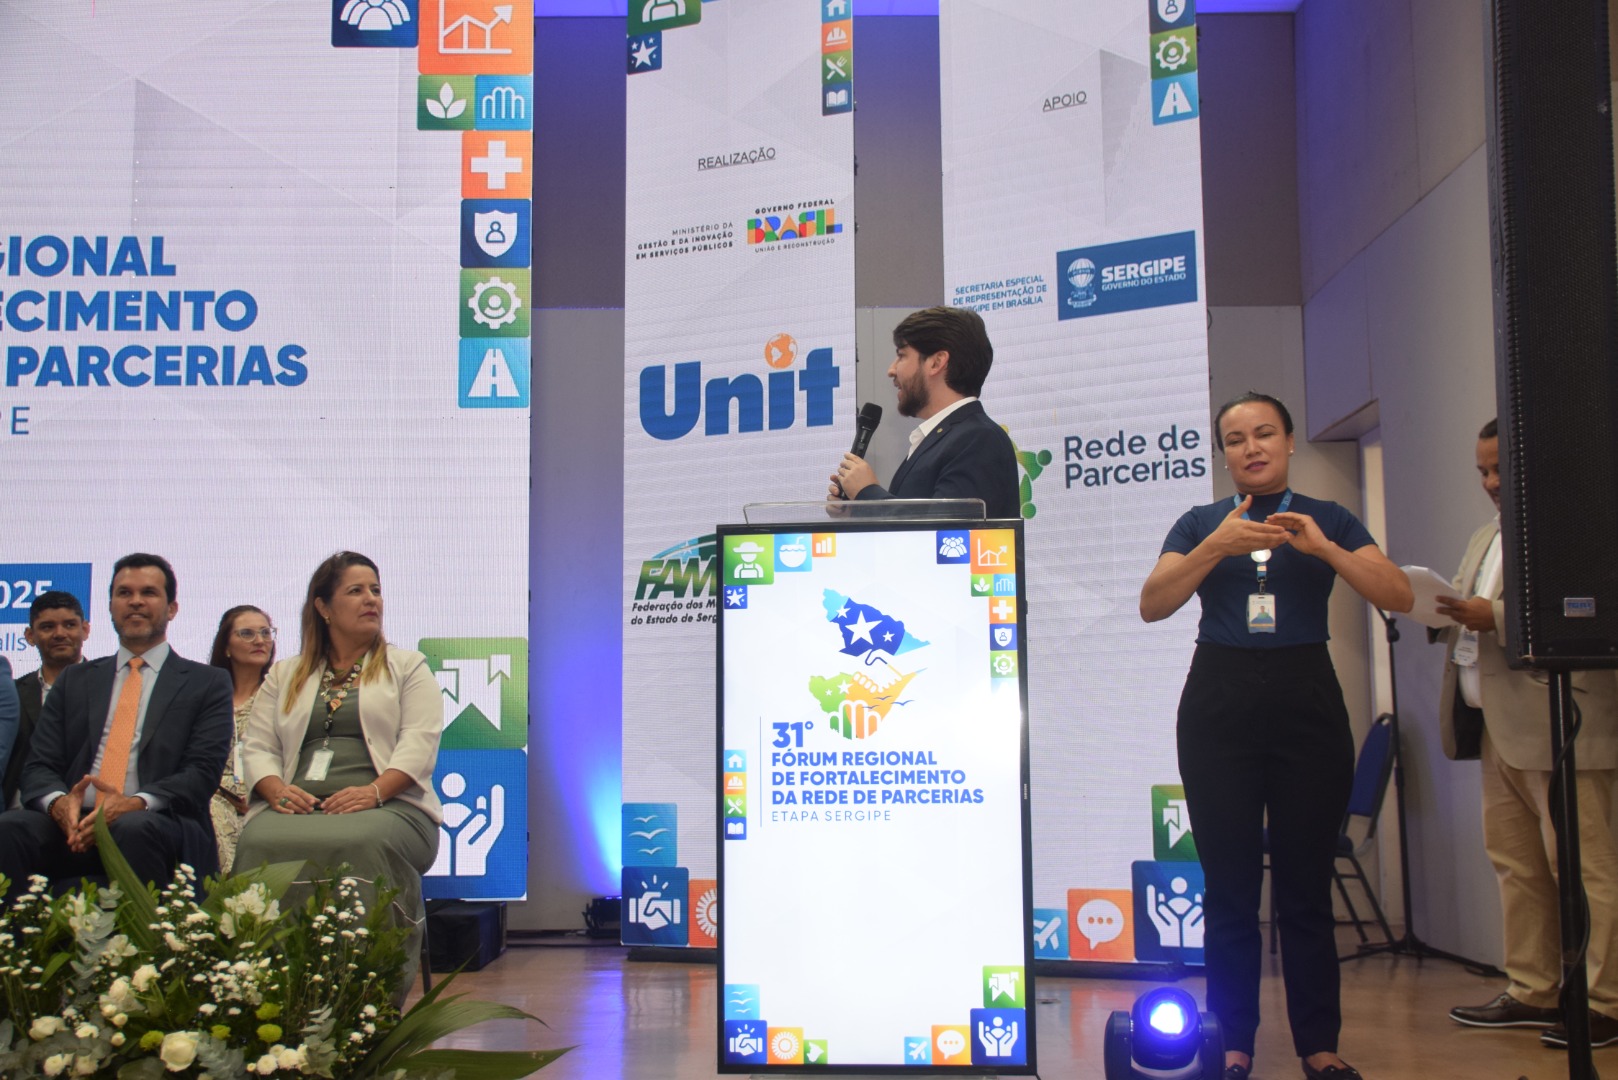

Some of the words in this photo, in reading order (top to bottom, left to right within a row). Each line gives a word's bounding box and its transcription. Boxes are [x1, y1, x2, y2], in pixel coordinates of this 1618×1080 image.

[1043, 91, 1087, 111] APOIO
[698, 147, 776, 170] REALIZAÇÃO
[755, 204, 794, 214] GOVERNO
[798, 199, 834, 209] FEDERAL
[672, 223, 719, 235] MINISTÉRIO
[747, 208, 843, 245] BRASIL
[638, 240, 668, 250] GESTÃO
[692, 231, 733, 243] INOVAÇÃO
[650, 247, 689, 258] SERVIÇOS
[692, 241, 733, 252] PÚBLICOS
[755, 244, 775, 253] UNIÃO
[784, 239, 835, 250] RECONSTRUÇÃO
[0, 235, 176, 277] IONAL
[1101, 255, 1186, 283] SERGIPE
[955, 281, 1004, 295] SECRETARIA
[1006, 275, 1044, 287] ESPECIAL
[1102, 279, 1139, 291] GOVERNO
[1141, 278, 1152, 286] DO
[1154, 273, 1186, 284] ESTADO
[953, 297, 964, 305] DE
[965, 286, 1034, 303] REPRESENTAÇÃO
[1036, 284, 1047, 293] DE
[992, 302, 1004, 310] EM
[1006, 296, 1043, 308] BRASÍLIA
[0, 290, 258, 332] CIMENTO
[6, 344, 308, 387] PARCERIAS
[639, 333, 840, 440] Unit
[1064, 430, 1147, 462] Rede
[1158, 424, 1200, 451] de
[1065, 453, 1206, 489] Parcerias
[632, 601, 683, 612] Federação
[686, 600, 703, 609] dos
[631, 616, 643, 625] do
[646, 614, 678, 624] Estado
[681, 613, 693, 623] de
[772, 749, 837, 767] FÓRUM
[842, 751, 938, 766] REGIONAL
[772, 771, 795, 786] DE
[800, 770, 966, 786] FORTALECIMENTO
[772, 790, 798, 805] DA
[802, 790, 848, 804] REDE
[853, 789, 878, 804] DE
[882, 789, 985, 804] PARCERIAS
[772, 810, 819, 822] ETAPA
[825, 810, 892, 821] SERGIPE
